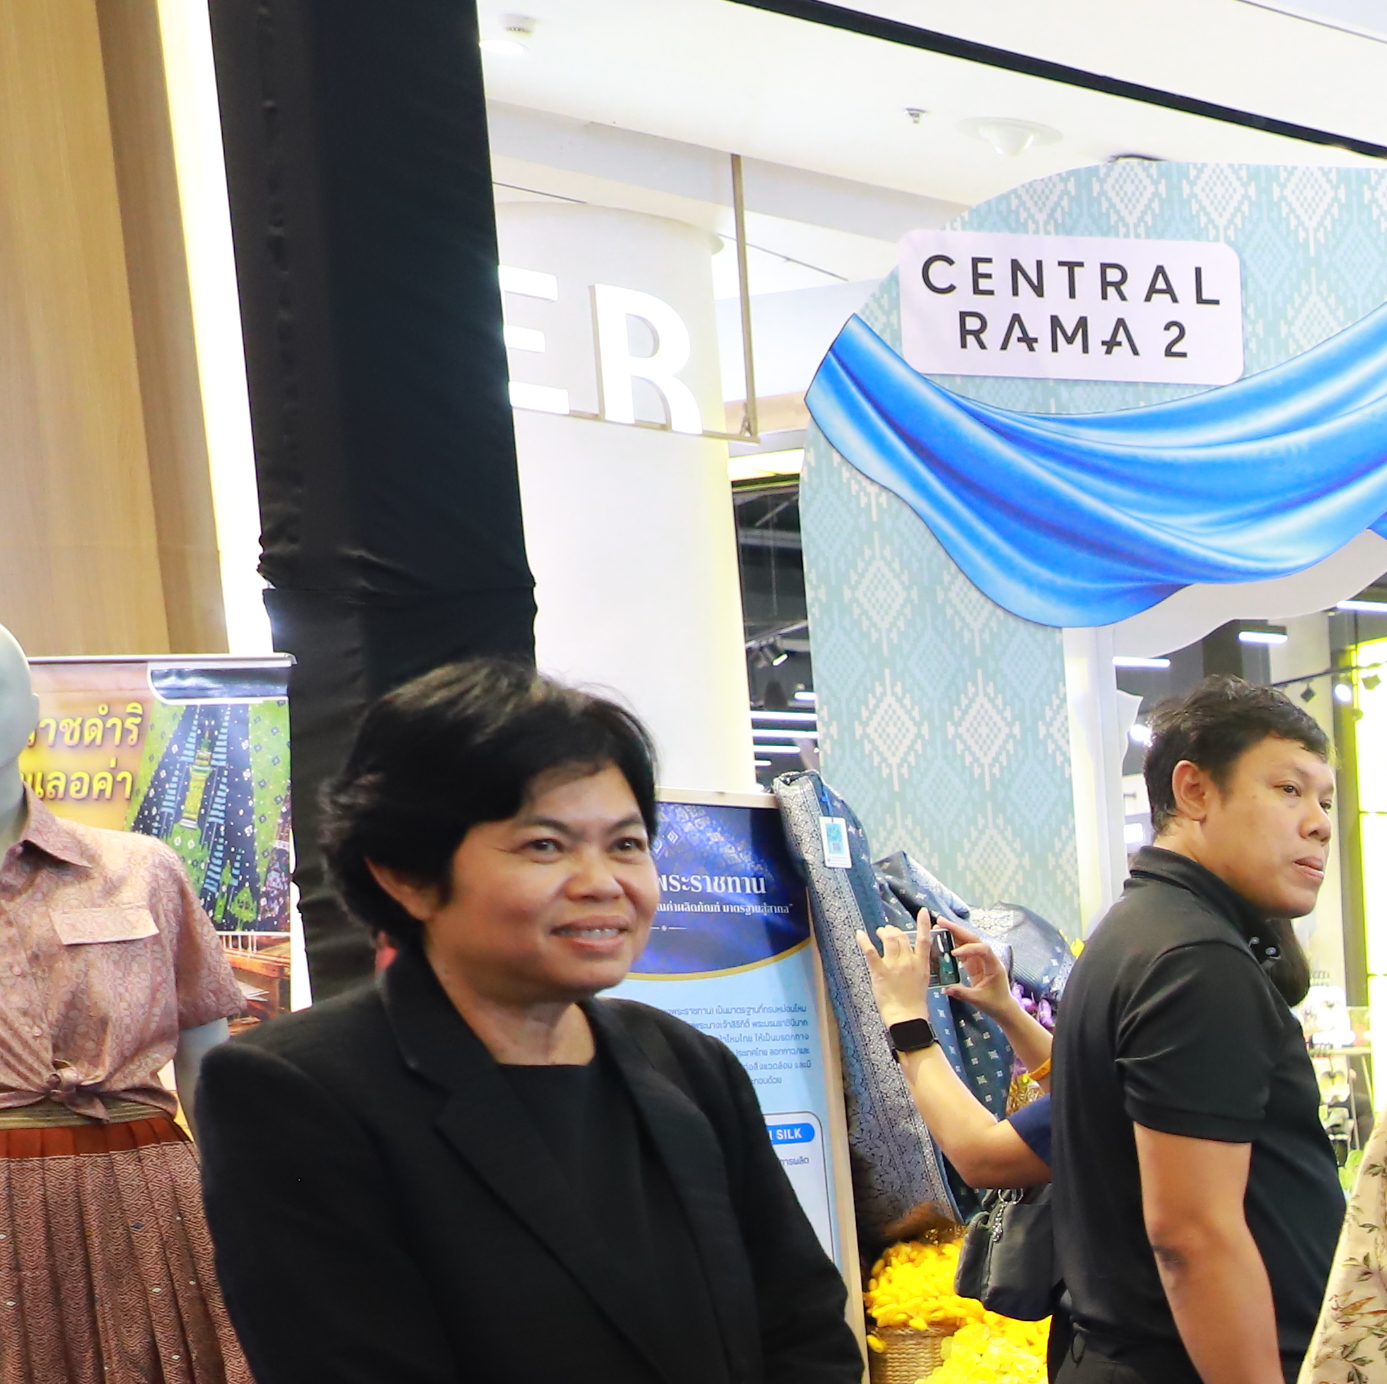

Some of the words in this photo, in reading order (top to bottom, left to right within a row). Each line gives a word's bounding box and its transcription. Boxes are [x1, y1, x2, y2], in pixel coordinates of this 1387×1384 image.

[920, 253, 1222, 307] CENTRAL
[958, 311, 1142, 358] RAMA
[1162, 320, 1190, 360] 2
[776, 1128, 802, 1140] SILK
